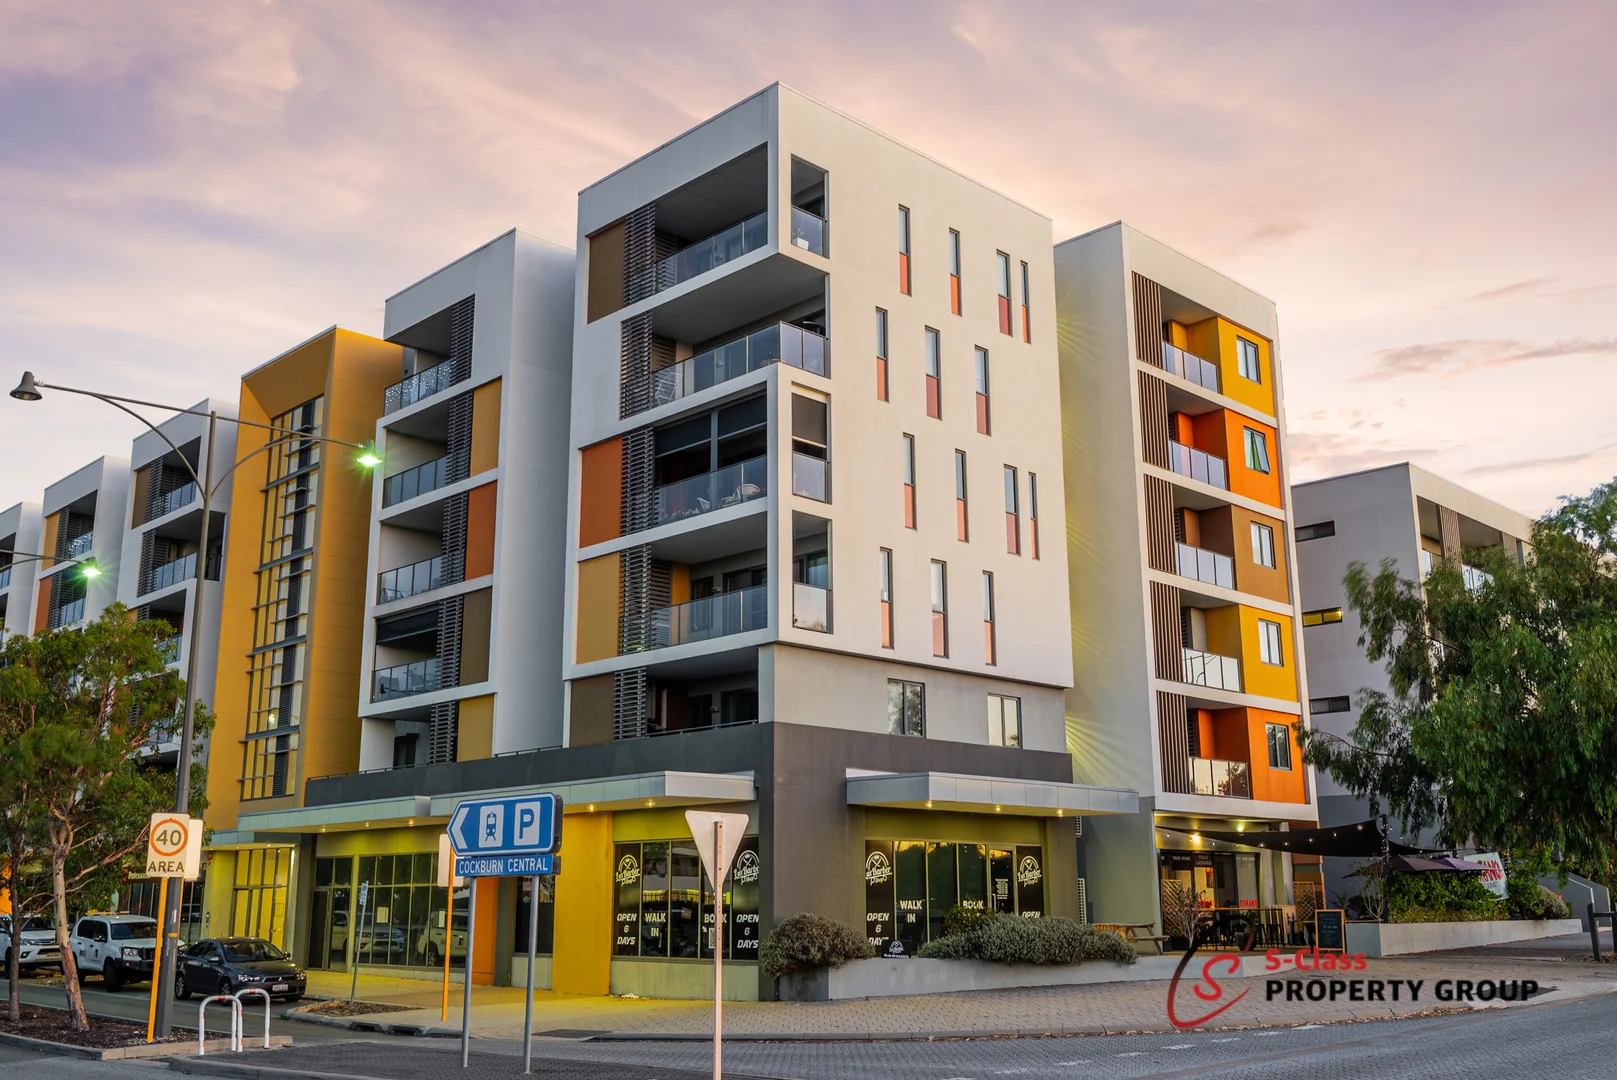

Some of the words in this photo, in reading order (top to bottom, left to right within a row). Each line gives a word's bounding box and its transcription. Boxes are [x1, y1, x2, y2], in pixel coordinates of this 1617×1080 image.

[519, 808, 534, 840] P
[155, 829, 182, 846] 40
[147, 861, 185, 873] AREA
[459, 859, 504, 875] COCKBURN
[507, 857, 548, 873] CENTRAL
[900, 900, 922, 910] WALK
[616, 913, 637, 922] OPEN
[644, 912, 666, 923] WALK
[704, 913, 728, 924] BOK
[736, 914, 760, 923] OPEN
[866, 912, 890, 922] OPEN
[907, 913, 916, 923] IN
[623, 924, 630, 933] 6
[650, 927, 659, 937] IN
[744, 927, 750, 936] 6
[875, 924, 882, 933] 6
[616, 936, 637, 946] DAYS
[737, 939, 760, 949] DAYS
